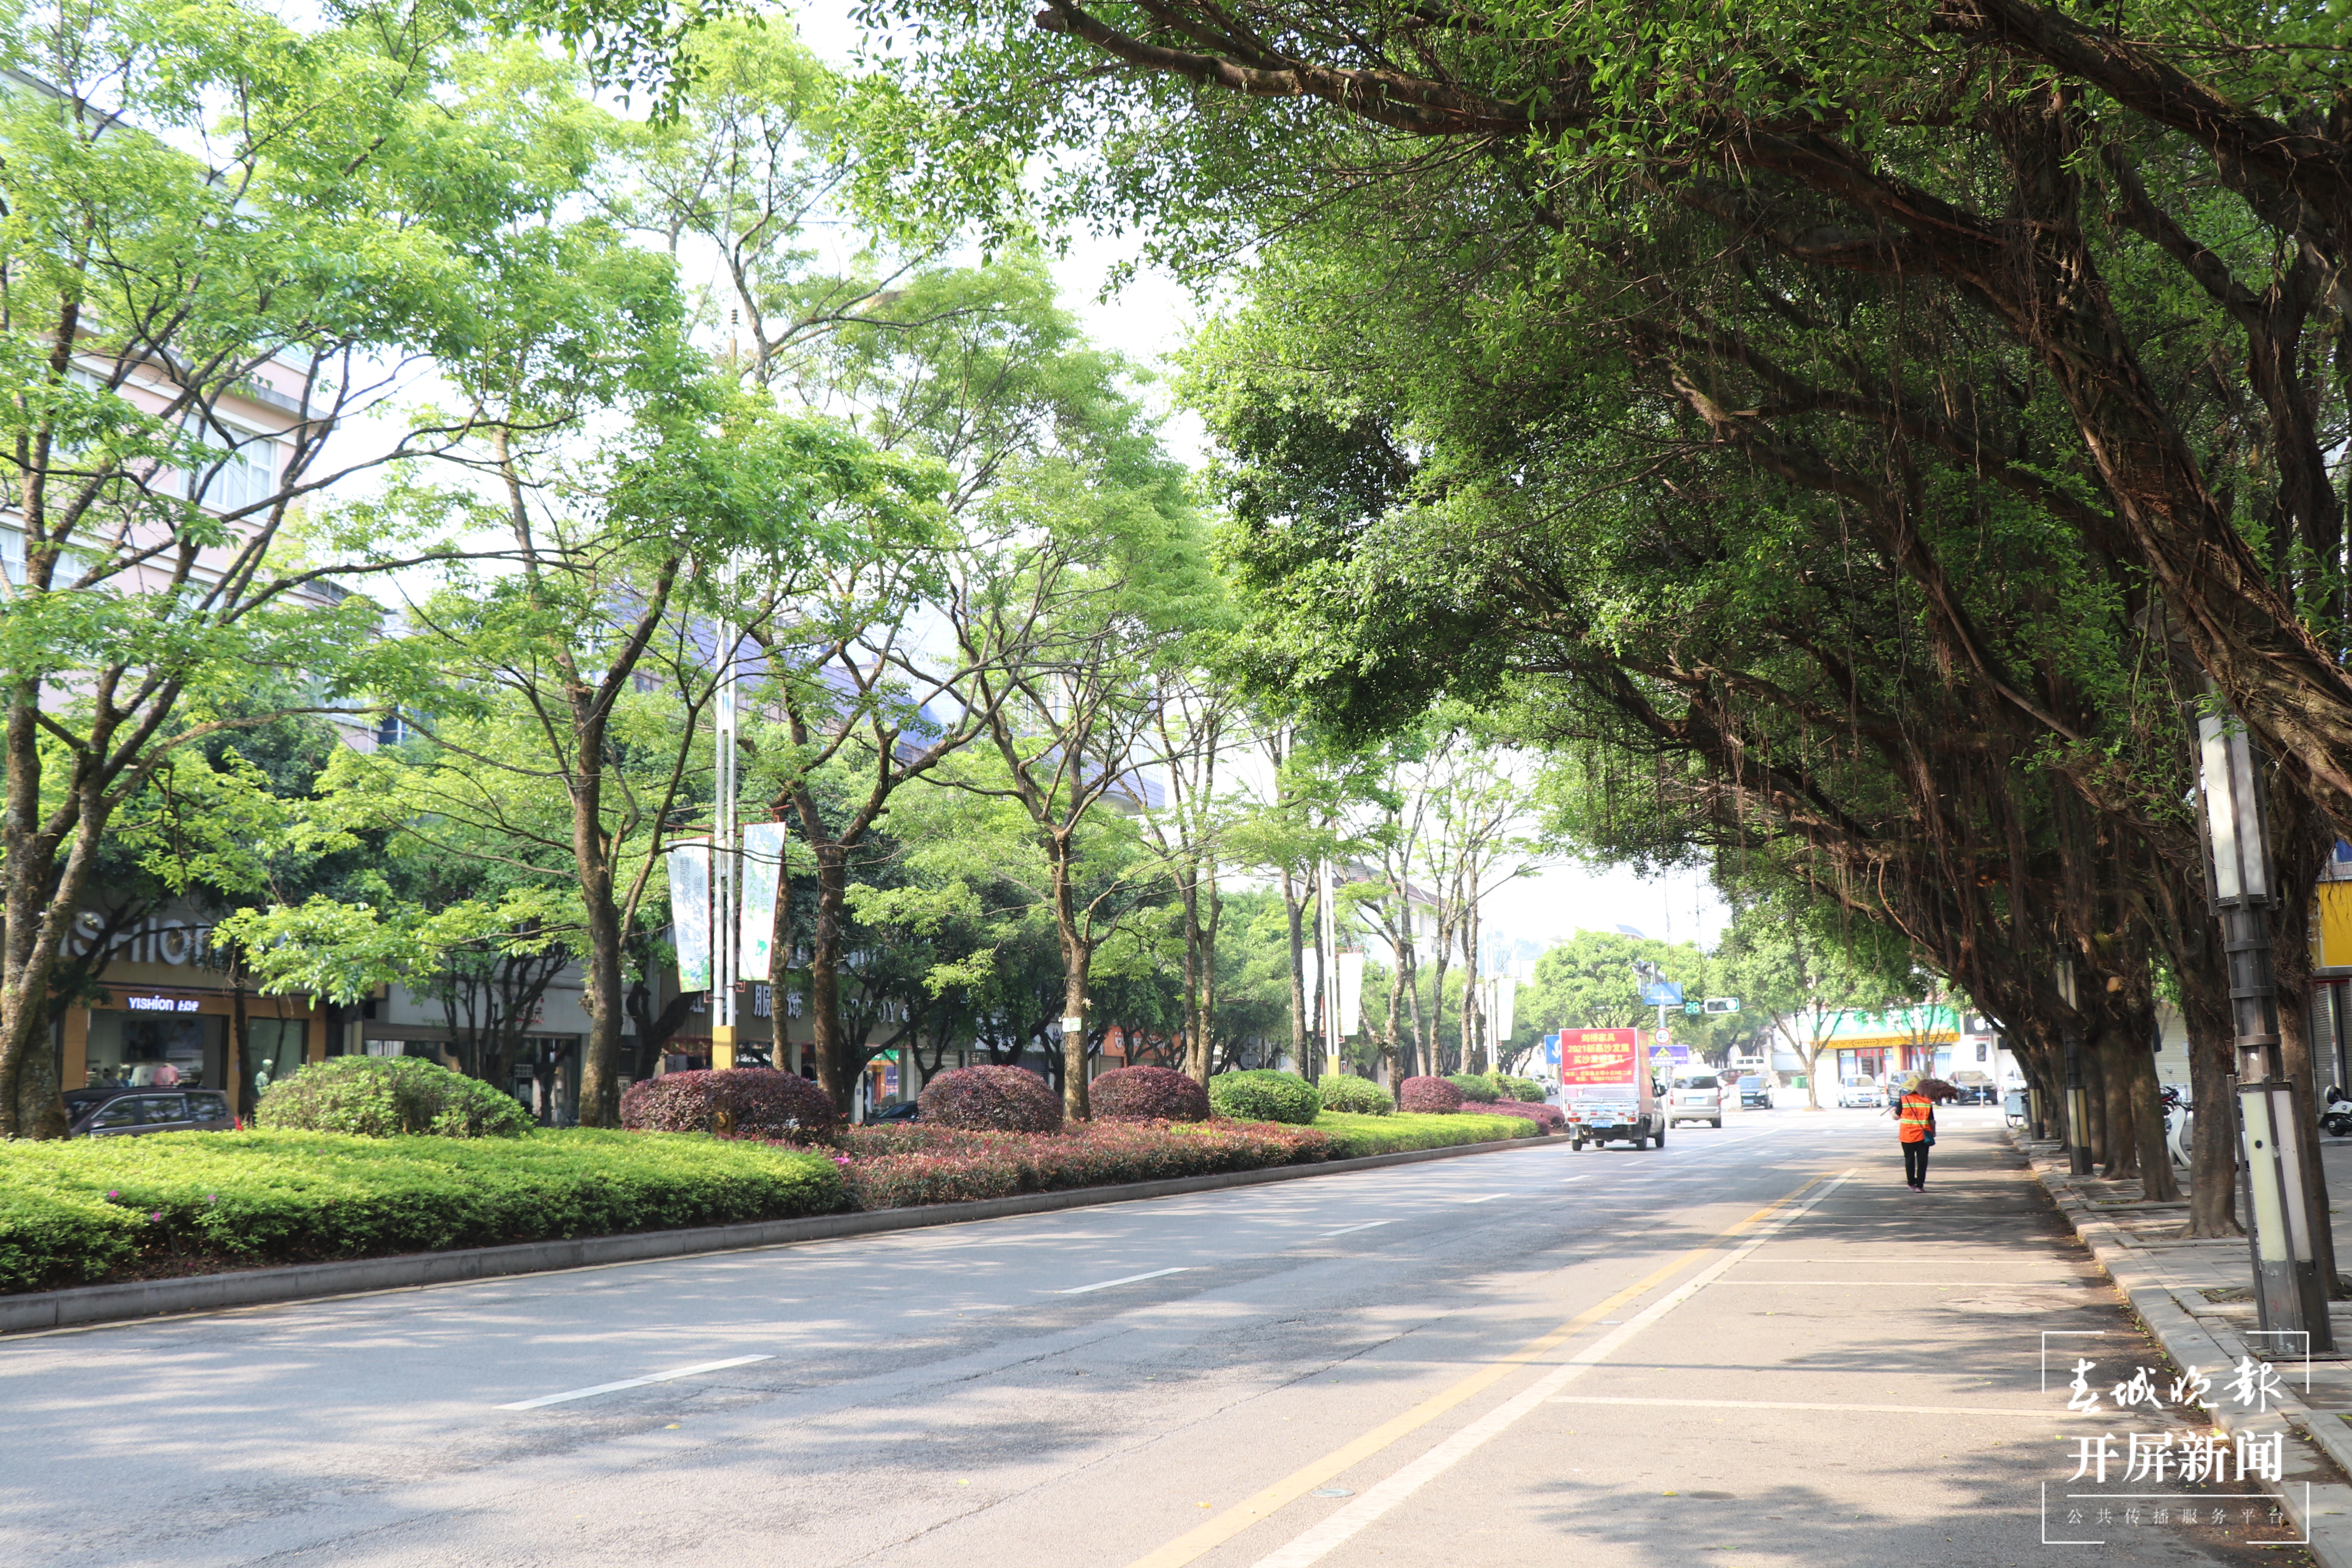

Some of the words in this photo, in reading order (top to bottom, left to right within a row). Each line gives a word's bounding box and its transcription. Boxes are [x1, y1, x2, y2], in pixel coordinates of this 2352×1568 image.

[1581, 1033, 1616, 1042] 剑桥家具
[1567, 1043, 1630, 1053] 2021新品沙发展
